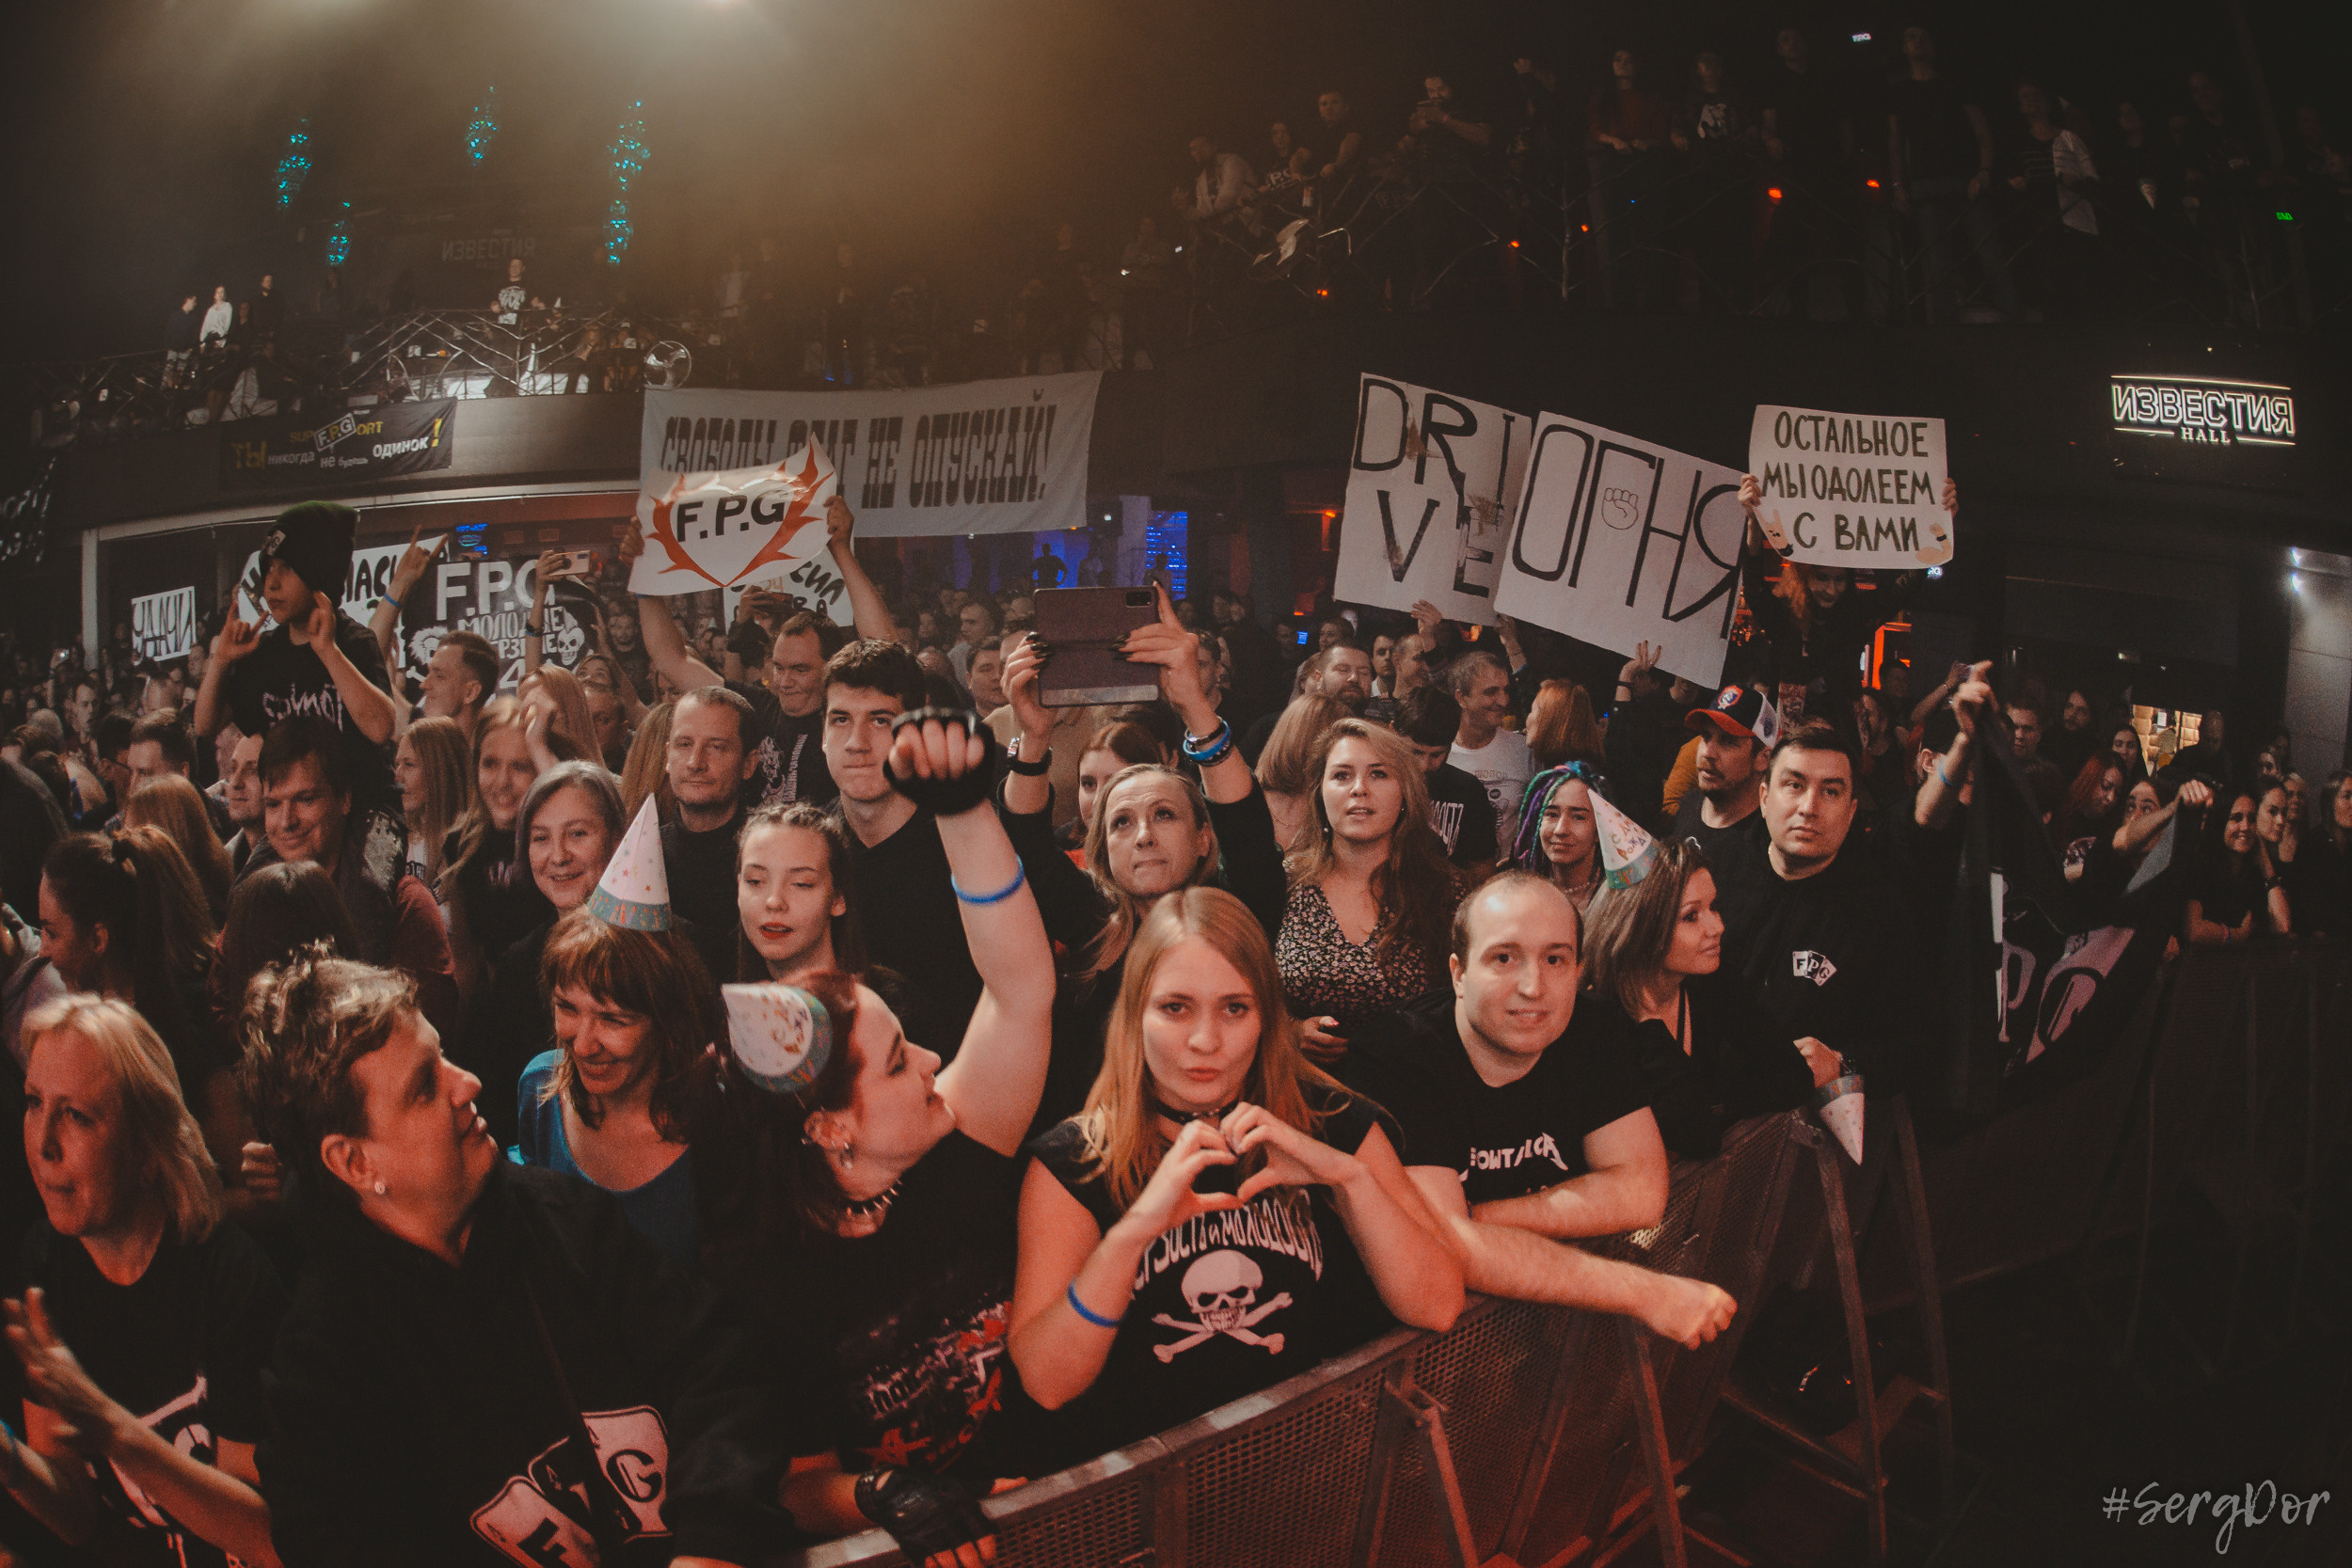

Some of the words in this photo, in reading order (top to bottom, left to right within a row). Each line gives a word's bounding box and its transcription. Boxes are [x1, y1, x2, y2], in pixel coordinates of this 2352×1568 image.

[1774, 410, 1929, 457] ОСТАЛЬНОЕ
[2111, 384, 2295, 436] ИЗВЕСТИЯ
[861, 416, 903, 509] НЕ
[910, 388, 1057, 509] ОПУСКАЙ!
[2181, 426, 2231, 444] HALL
[1811, 464, 1935, 506] ОДОЛЕЕМ
[676, 489, 787, 543] F.P.G
[1793, 512, 1818, 549] С
[1835, 514, 1920, 552] ВАМИ
